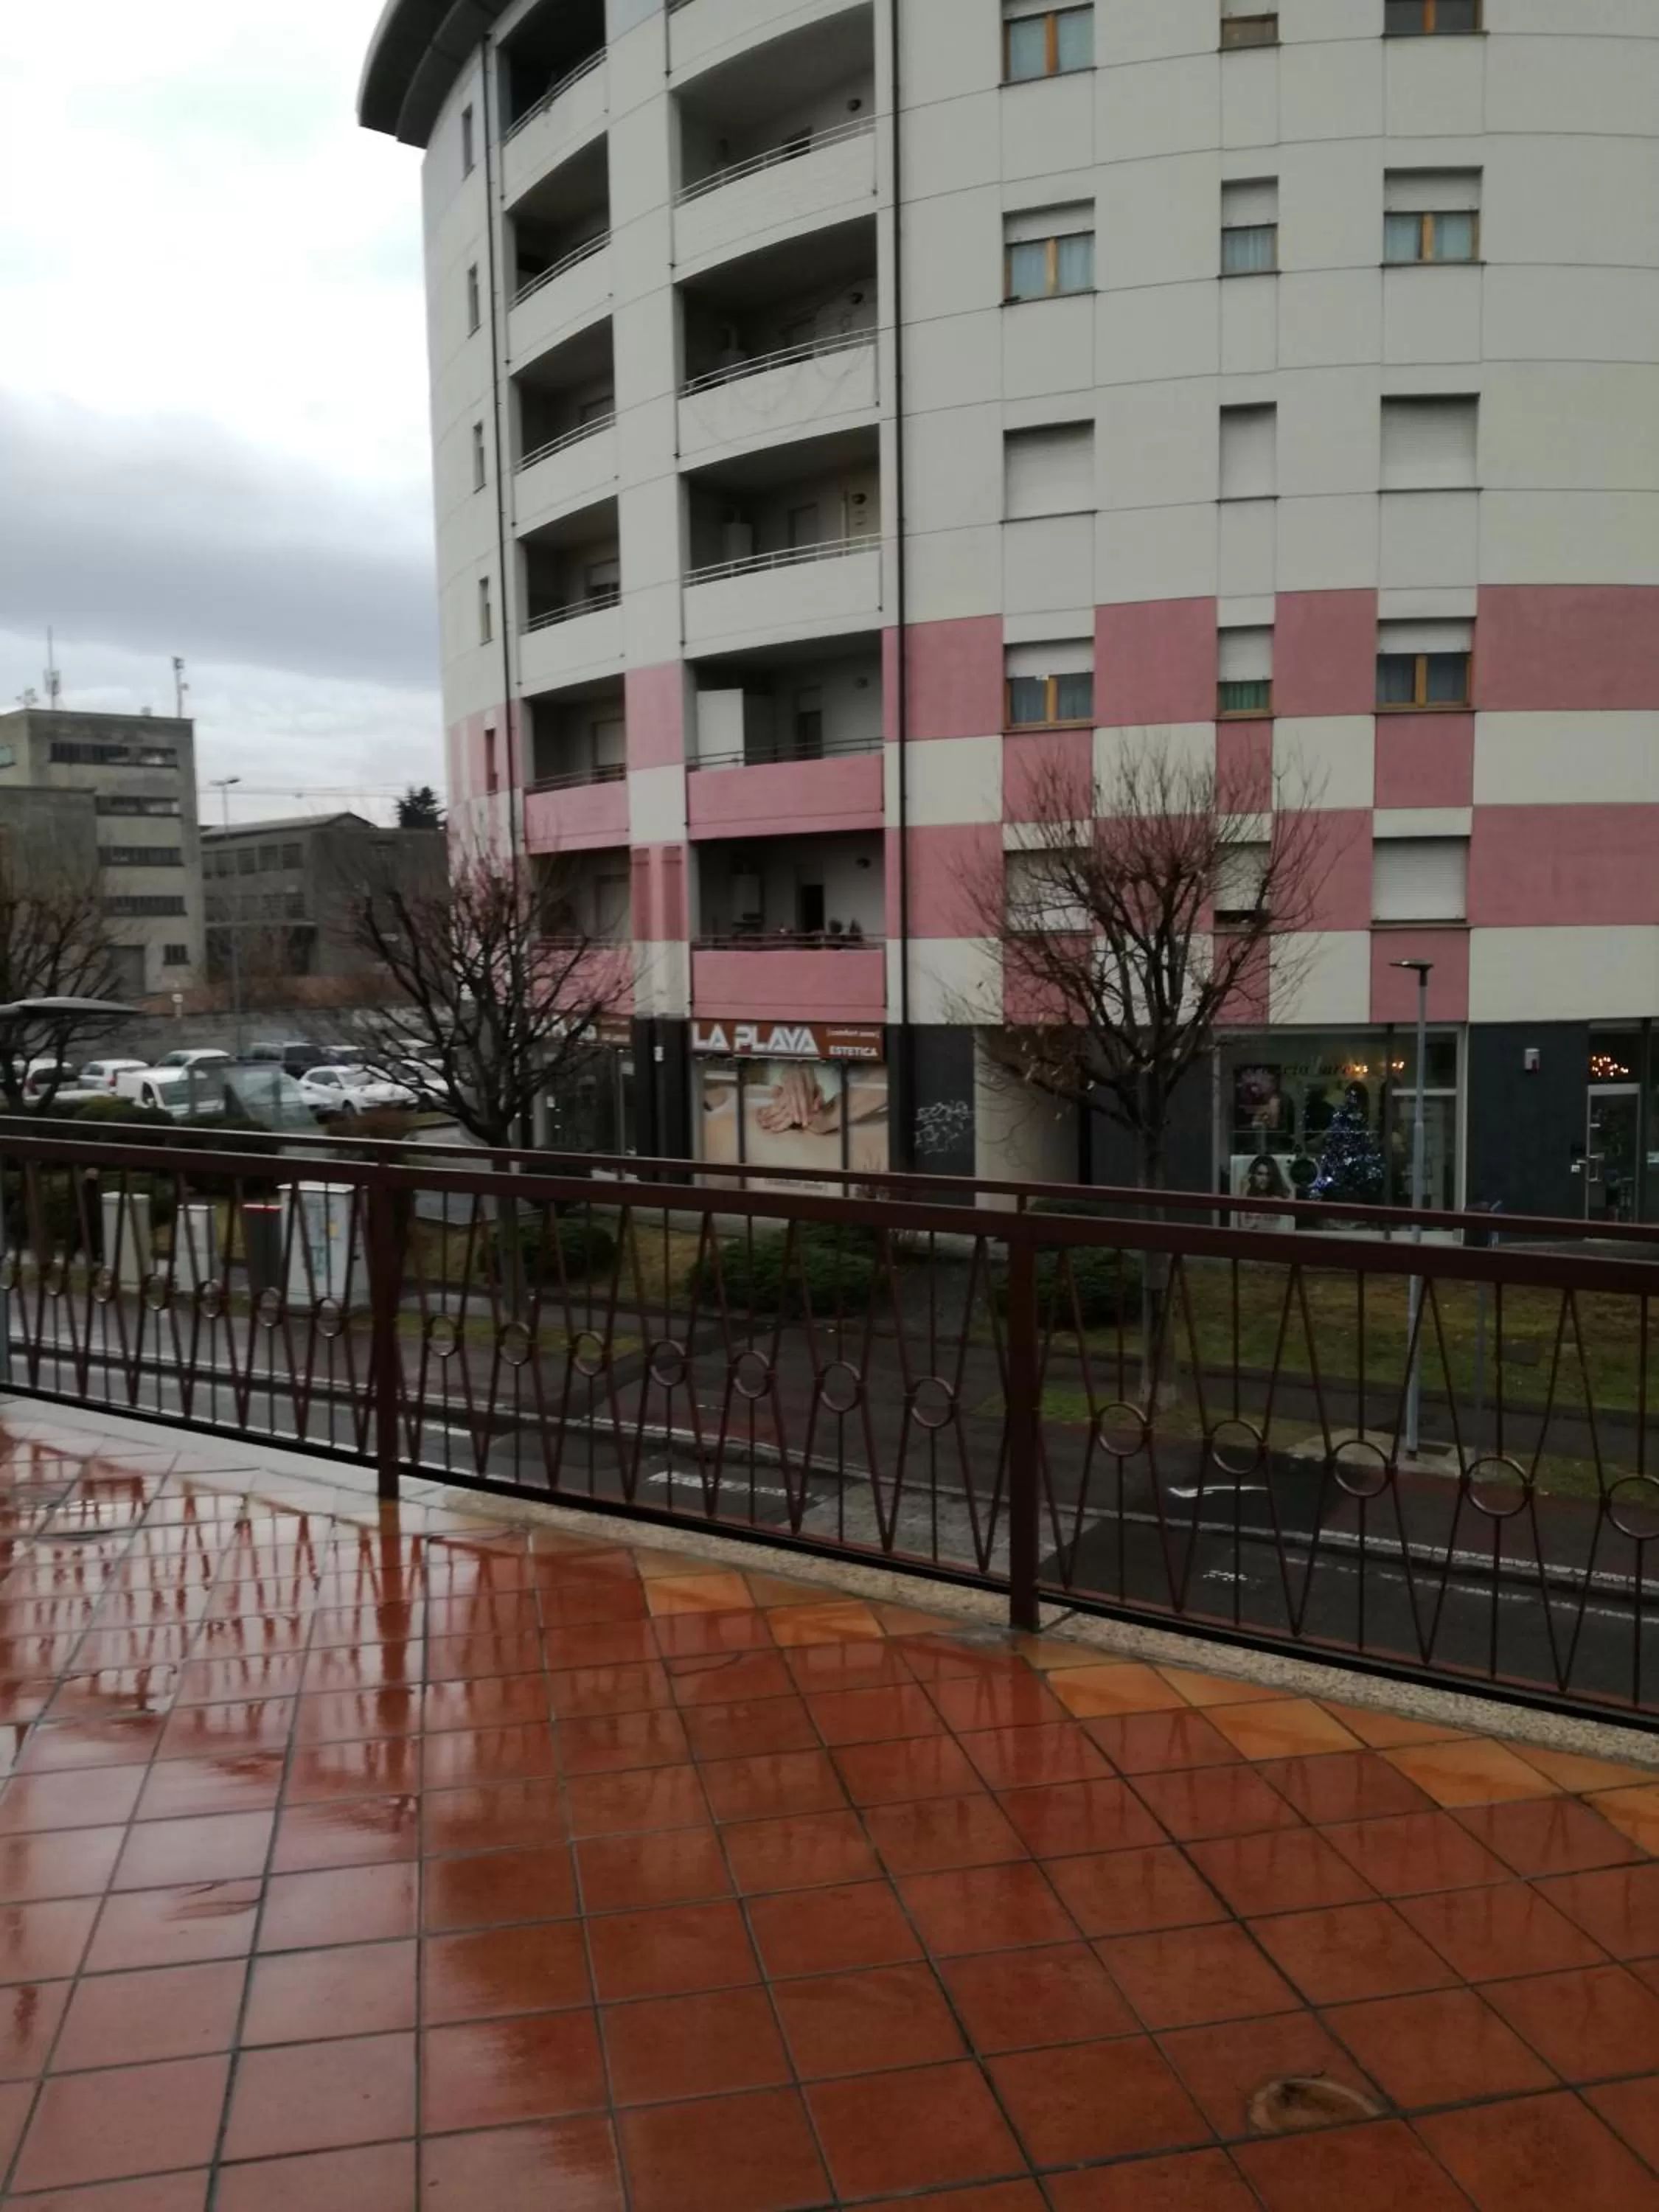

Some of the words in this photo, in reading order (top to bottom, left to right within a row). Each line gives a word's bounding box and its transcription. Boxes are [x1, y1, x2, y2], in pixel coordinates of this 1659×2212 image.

[691, 1022, 731, 1051] LA
[734, 1025, 820, 1055] PLAYA
[828, 1045, 878, 1057] ESTETICA
